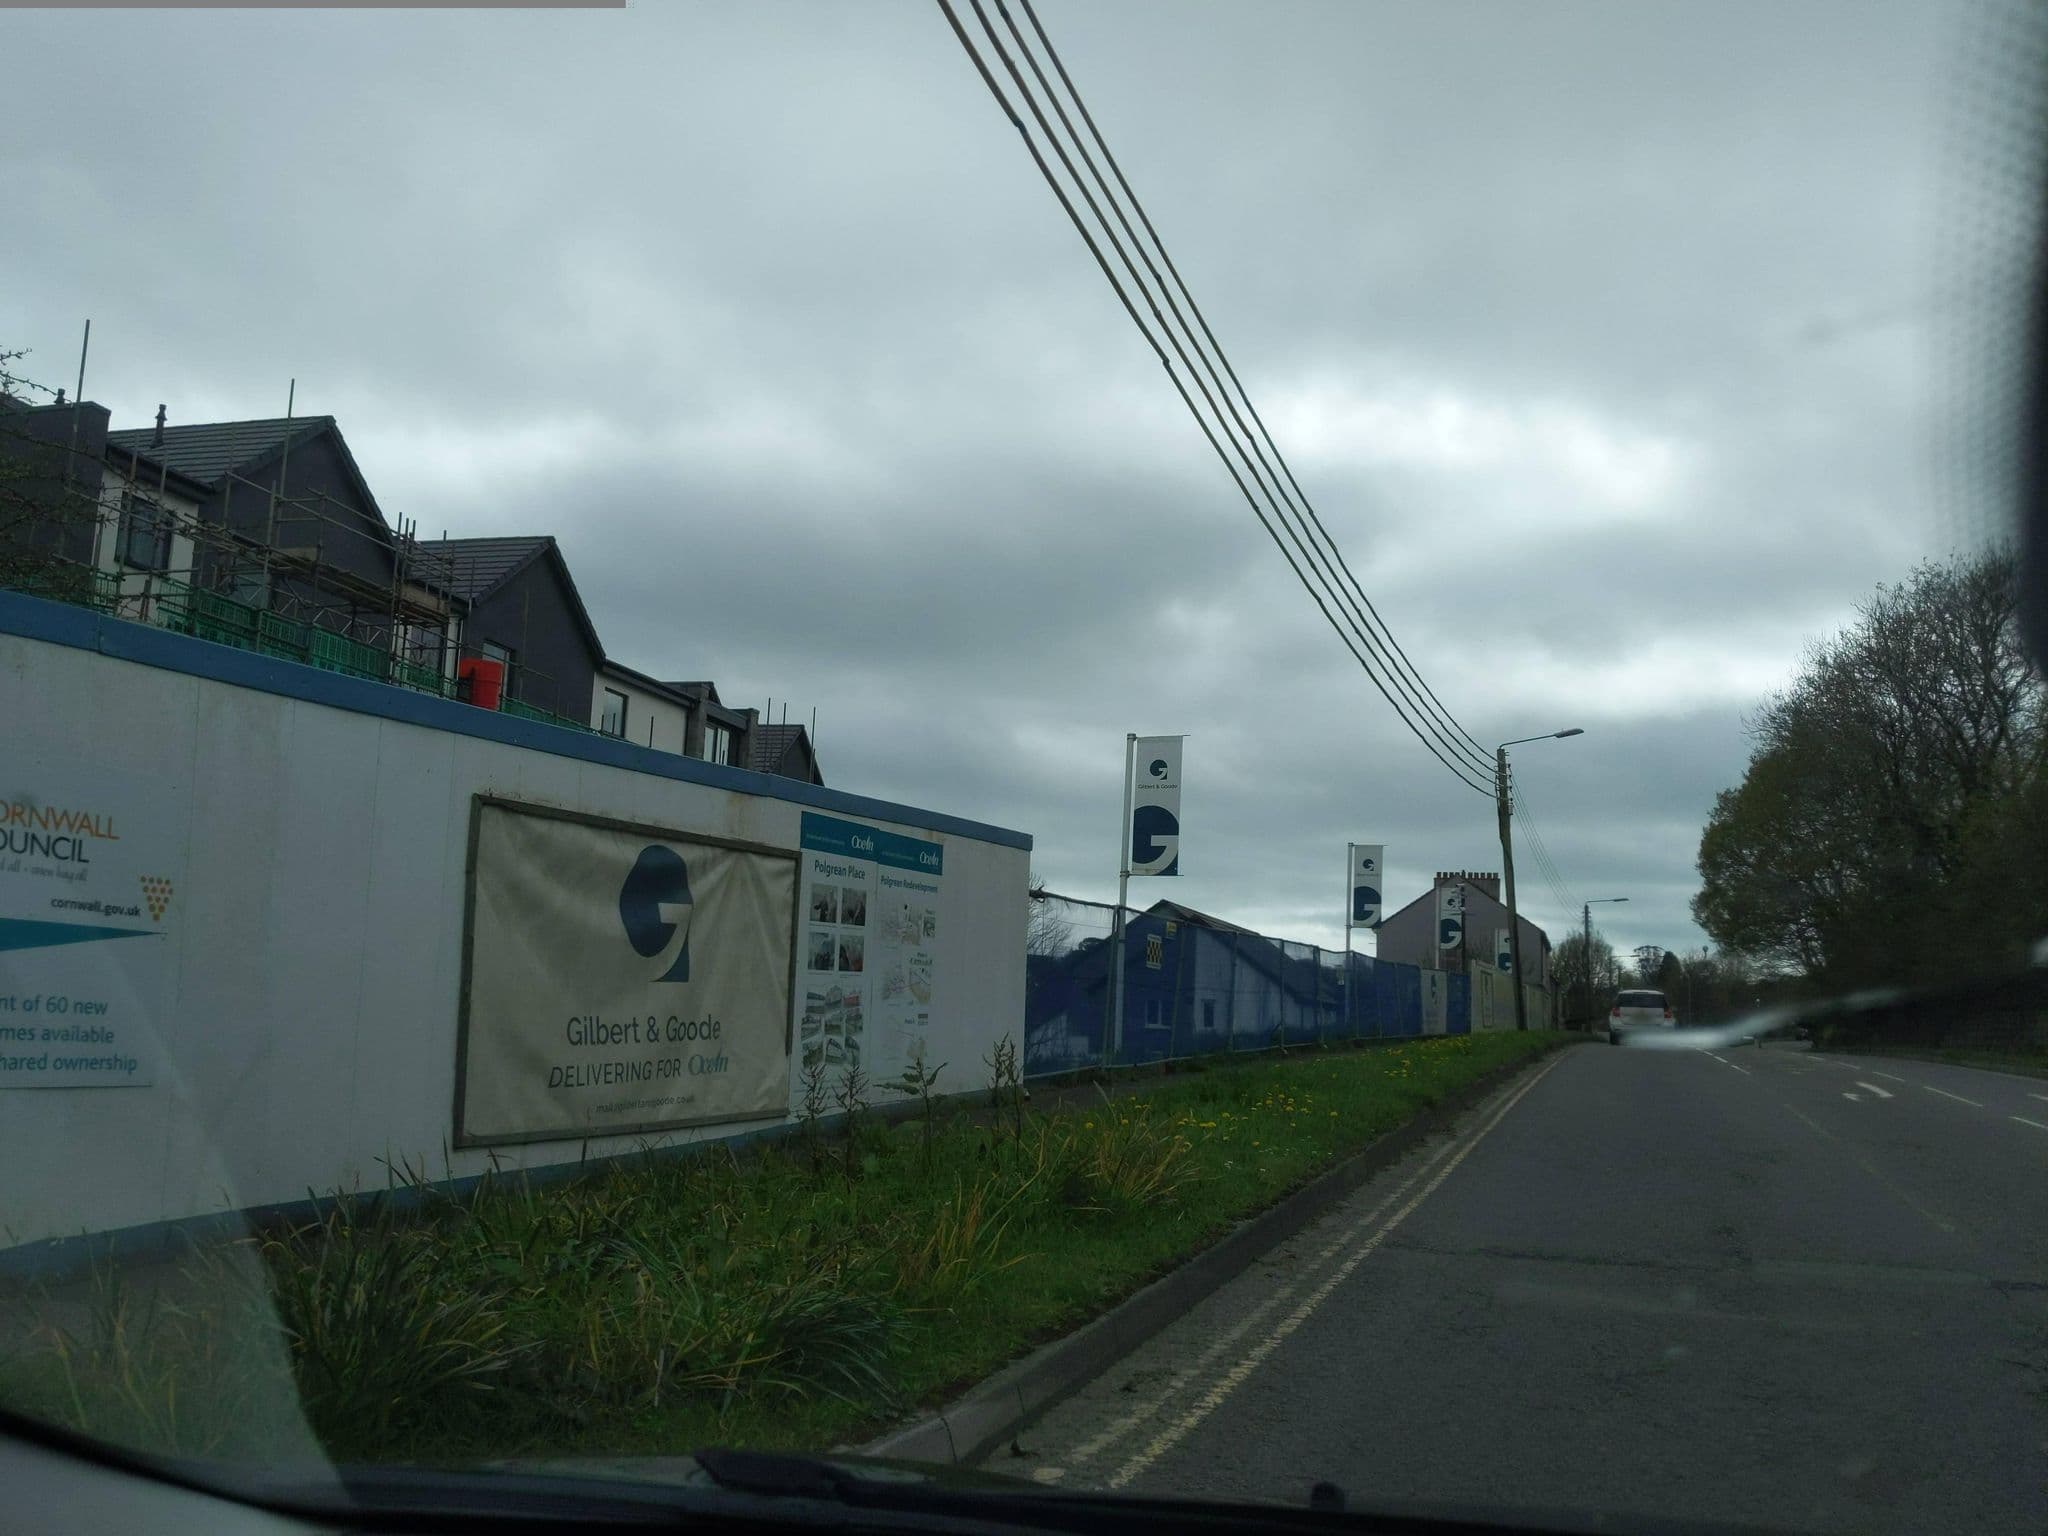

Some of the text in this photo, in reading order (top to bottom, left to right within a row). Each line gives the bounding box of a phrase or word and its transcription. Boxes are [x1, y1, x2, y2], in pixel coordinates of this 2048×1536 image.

[814, 860, 866, 880] Polgrean Place
[51, 897, 141, 917] cornwall.gov.uk
[23, 993, 42, 1012] of
[46, 995, 68, 1013] 60
[74, 1001, 108, 1016] new
[41, 1026, 115, 1044] available
[567, 1014, 721, 1046] Gilbert & Goode
[53, 1053, 138, 1075] ownership
[548, 1060, 653, 1088] DELIVERING
[656, 1058, 681, 1079] FOR
